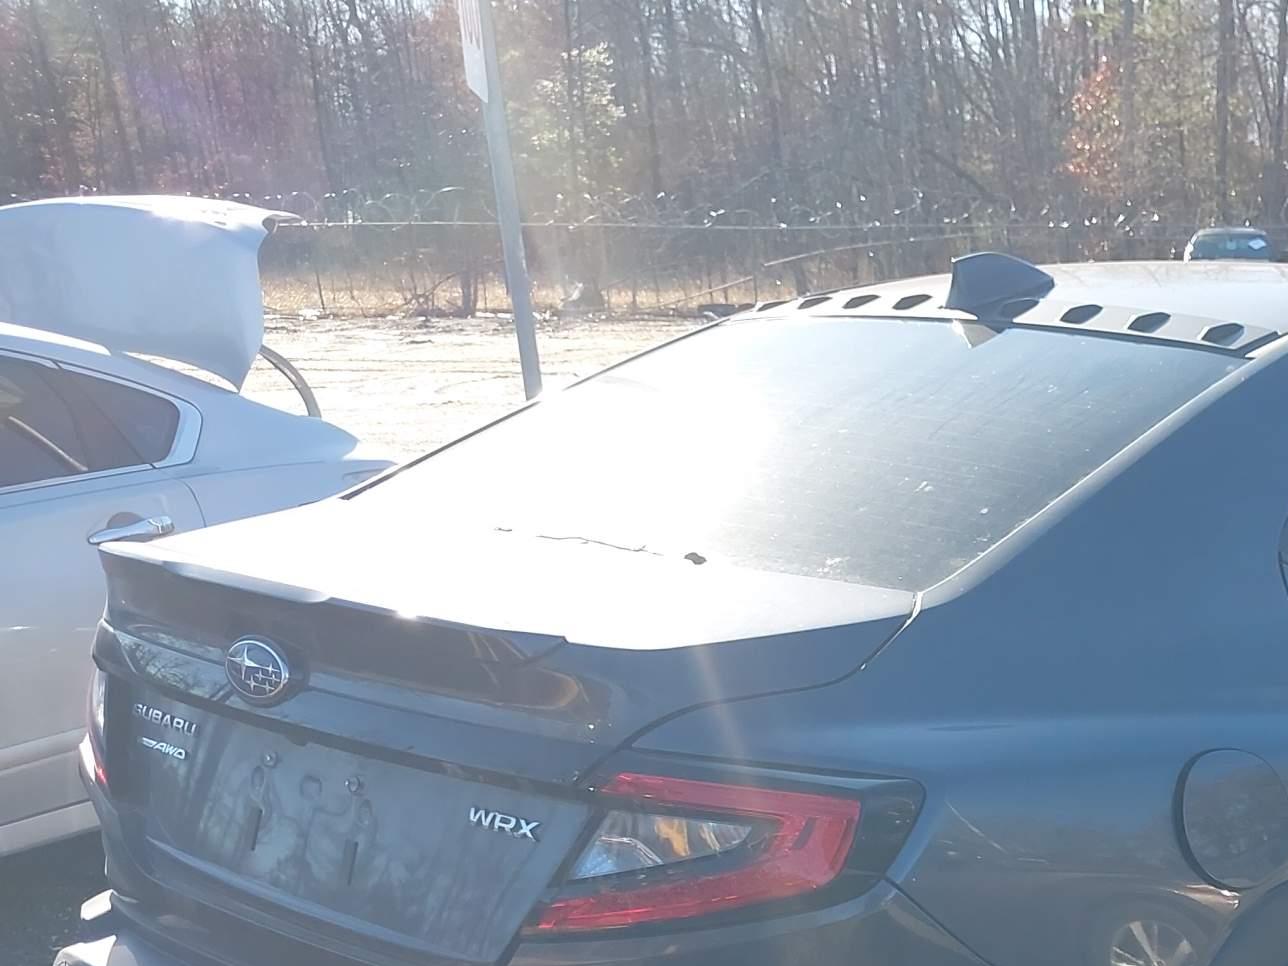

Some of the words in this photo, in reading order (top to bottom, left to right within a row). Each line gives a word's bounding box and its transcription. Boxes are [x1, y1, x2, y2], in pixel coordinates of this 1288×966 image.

[133, 703, 197, 737] SUBARU
[152, 741, 186, 760] AWD
[469, 807, 540, 842] WRX
